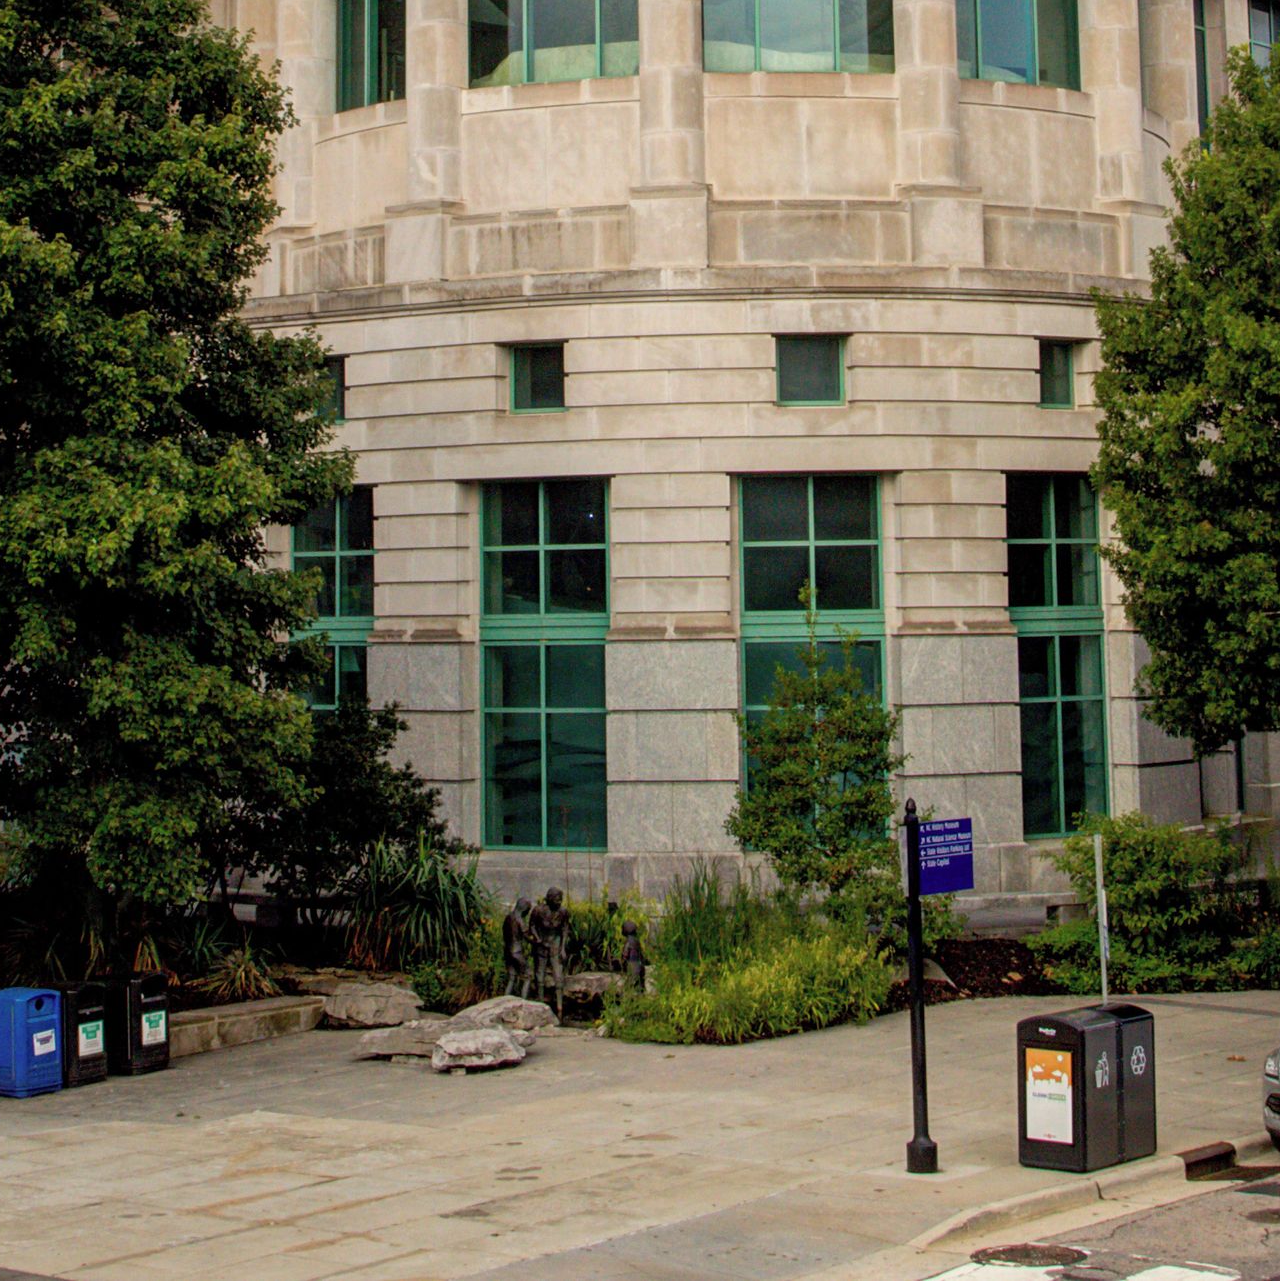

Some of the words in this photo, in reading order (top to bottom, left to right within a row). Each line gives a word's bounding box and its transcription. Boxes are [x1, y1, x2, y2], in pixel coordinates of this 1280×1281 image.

[945, 821, 959, 829] Museum
[958, 832, 972, 840] Museum
[950, 845, 964, 853] Parking
[936, 858, 949, 867] Capitol
